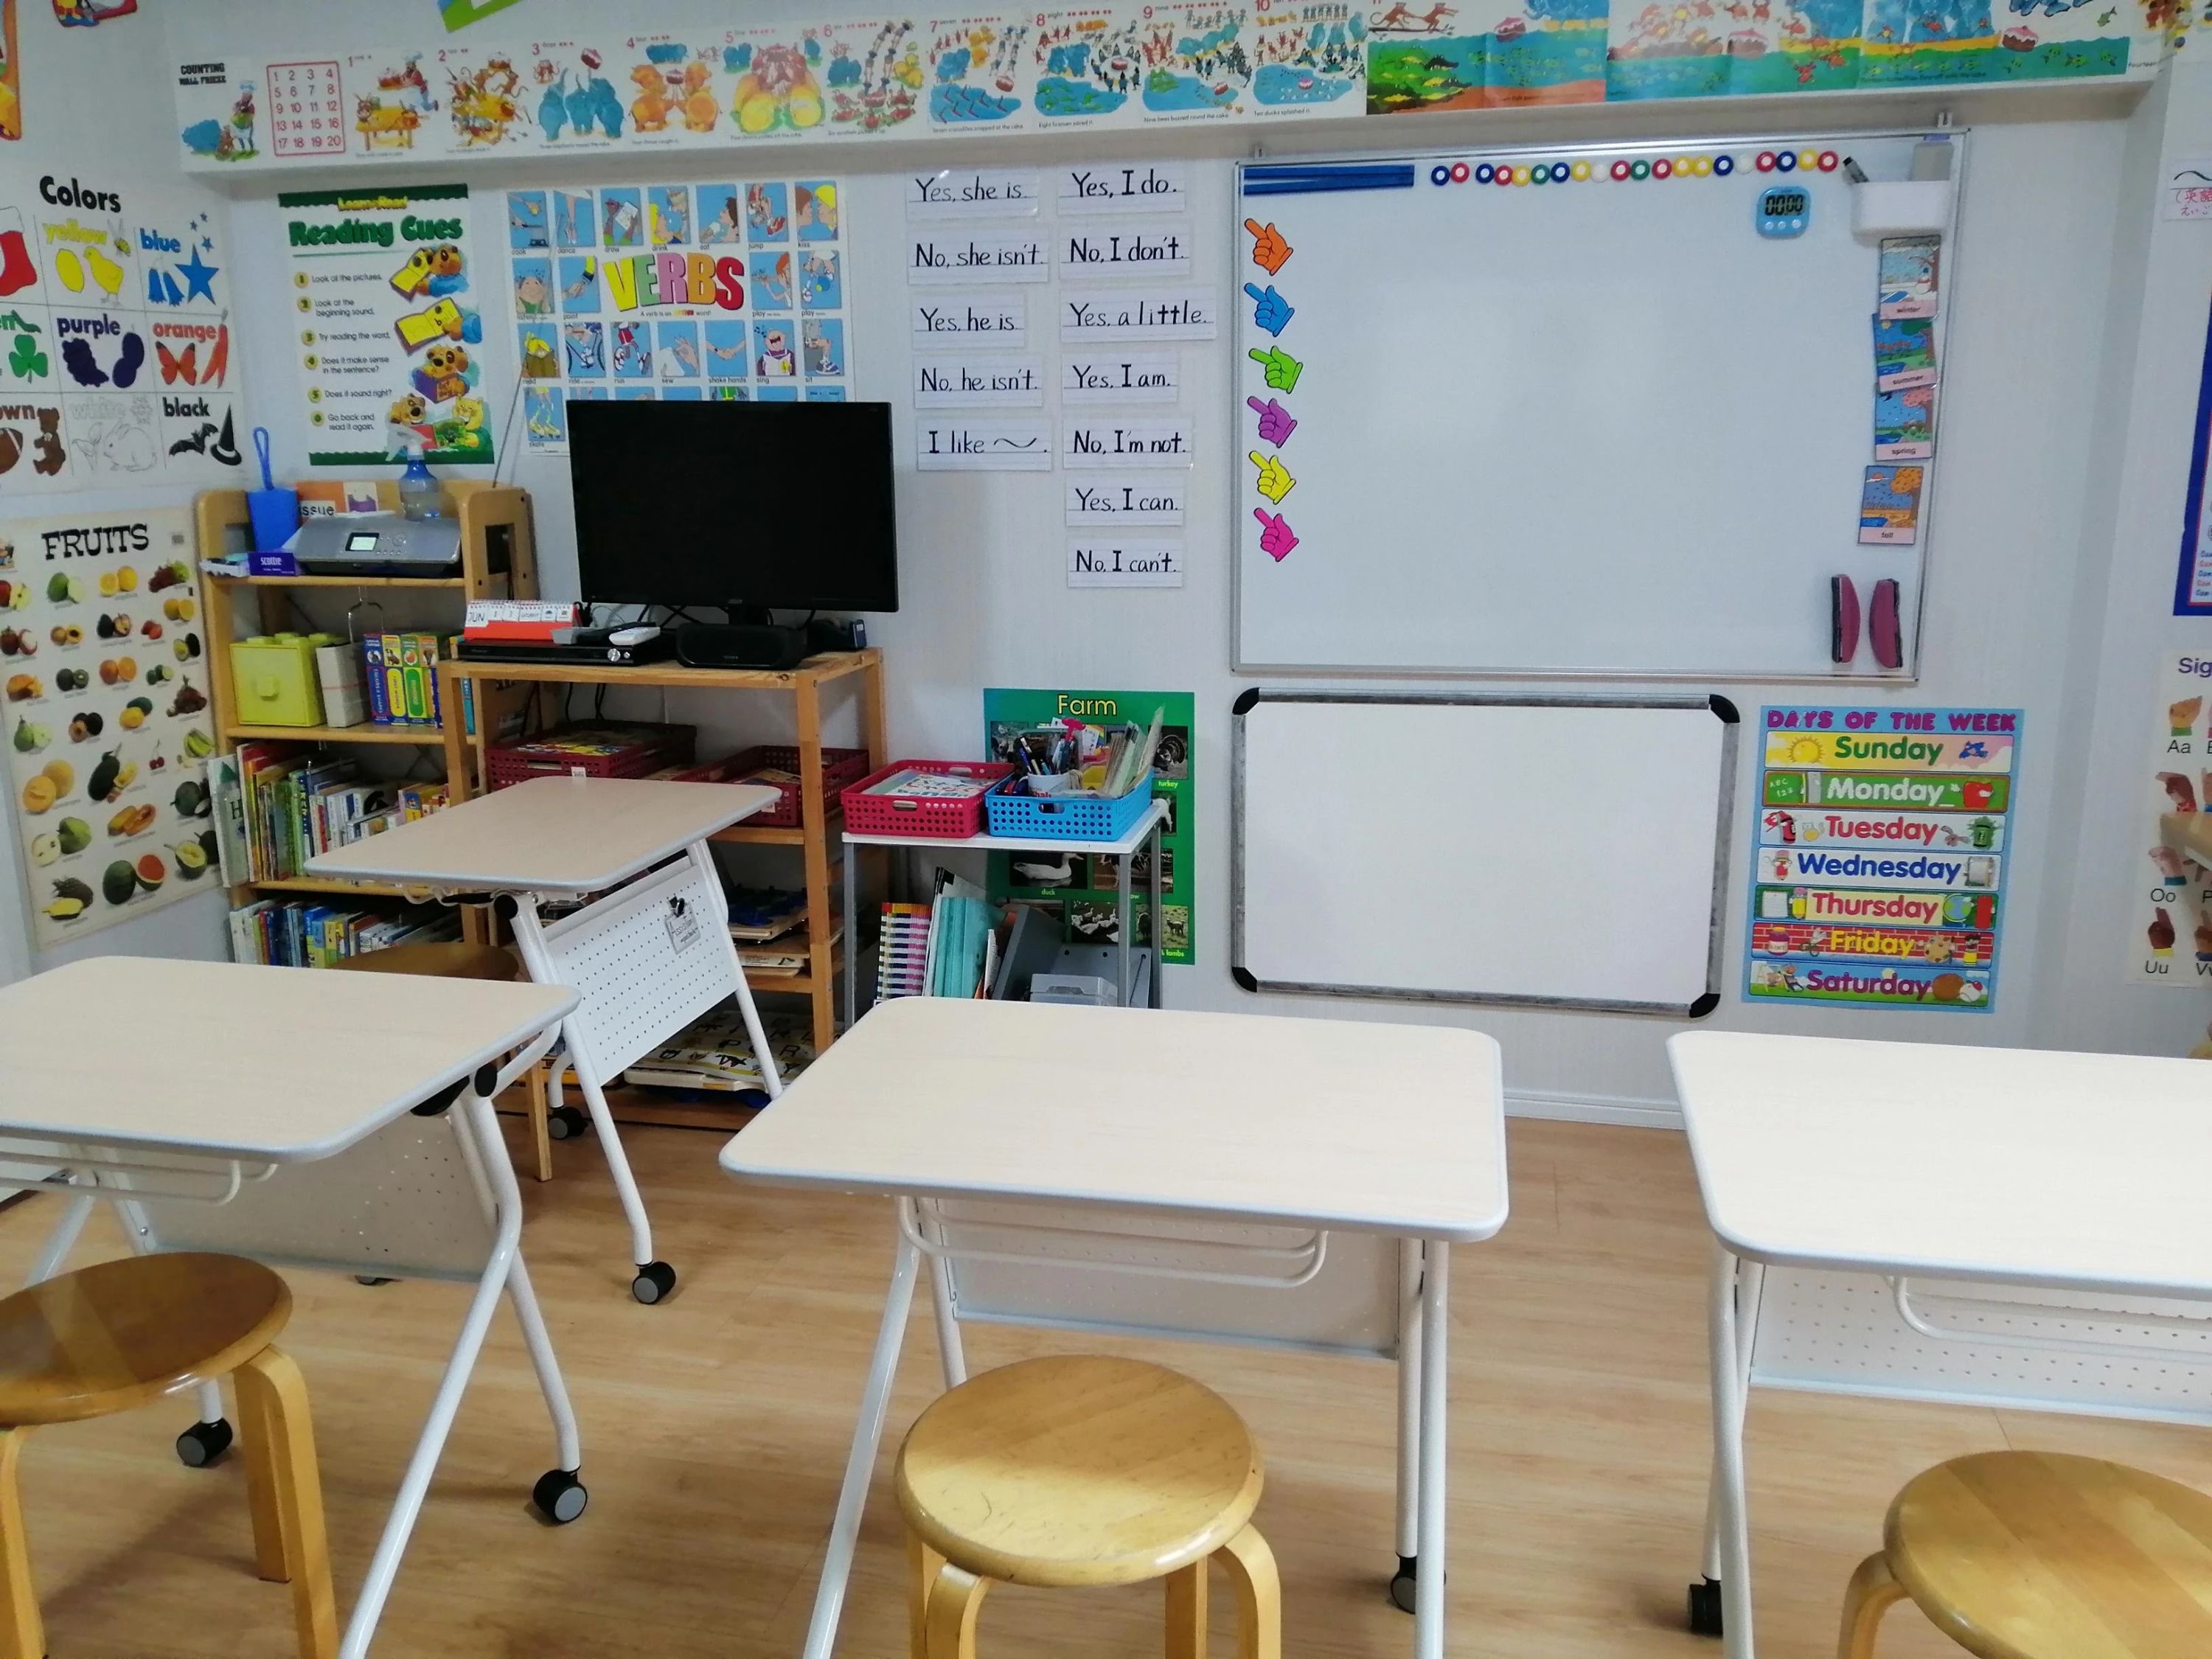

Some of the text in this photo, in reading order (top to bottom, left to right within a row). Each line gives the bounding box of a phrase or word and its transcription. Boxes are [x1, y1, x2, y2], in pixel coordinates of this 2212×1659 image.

[1143, 6, 1152, 18] 9
[1255, 0, 1270, 12] 10
[930, 21, 938, 32] 7
[1036, 13, 1046, 26] 8
[181, 63, 225, 74] COUNTING
[274, 69, 333, 81] 1 2 3 4
[179, 75, 226, 86] WALL FRIEZE
[274, 84, 334, 97] 5 6 7 8
[276, 100, 337, 114] 9 10 11 12
[276, 117, 339, 131] 13 14 15 16
[278, 135, 341, 148] 17 18 19 20
[39, 175, 121, 213] Colors
[915, 177, 956, 203] Yes,
[961, 176, 998, 201] she
[1071, 168, 1178, 199] Yes, I do.
[42, 218, 108, 245] yellow
[139, 228, 181, 253] blue
[288, 215, 463, 247] Reading Cues
[748, 243, 764, 251] jump
[916, 242, 1044, 268] No, she isn't.
[1071, 236, 1184, 263] No, I don't.
[602, 252, 745, 313] VERBS
[752, 310, 766, 319] play
[801, 310, 815, 318] play
[920, 307, 961, 333] Yes,
[967, 307, 992, 331] he
[1069, 300, 1208, 327] Yes, a little.
[58, 313, 121, 339] purple
[153, 321, 216, 343] orange
[921, 367, 1038, 392] No, he isn't.
[1072, 364, 1171, 389] Yes, I am.
[1893, 375, 1924, 385] summer
[162, 396, 210, 418] black
[928, 430, 984, 454] I like
[1074, 430, 1186, 455] No, I'm not.
[1891, 446, 1916, 456] spring
[299, 505, 335, 516] issue
[1075, 488, 1178, 512] Yes, I can.
[41, 523, 149, 560] FRUITS
[1881, 531, 1893, 539] fall
[1076, 549, 1177, 572] No, I can't.
[467, 611, 486, 623] JUN
[2178, 657, 2212, 678] Sig
[1057, 693, 1117, 717] Farm
[1767, 710, 2017, 732] DAYS OF THE WEEK
[1834, 736, 1944, 765] Sunday
[2167, 740, 2191, 754] Aa
[1158, 781, 1178, 789] turkey
[1826, 777, 1945, 807] Monday
[1825, 816, 1938, 846] Tuesday
[1798, 852, 1961, 885] Wednesday
[2151, 888, 2176, 902] Oo
[1812, 892, 1938, 924] Thursday
[1830, 931, 1915, 959] Friday
[2145, 960, 2168, 974] Uu
[1806, 970, 1933, 1001] Saturday
